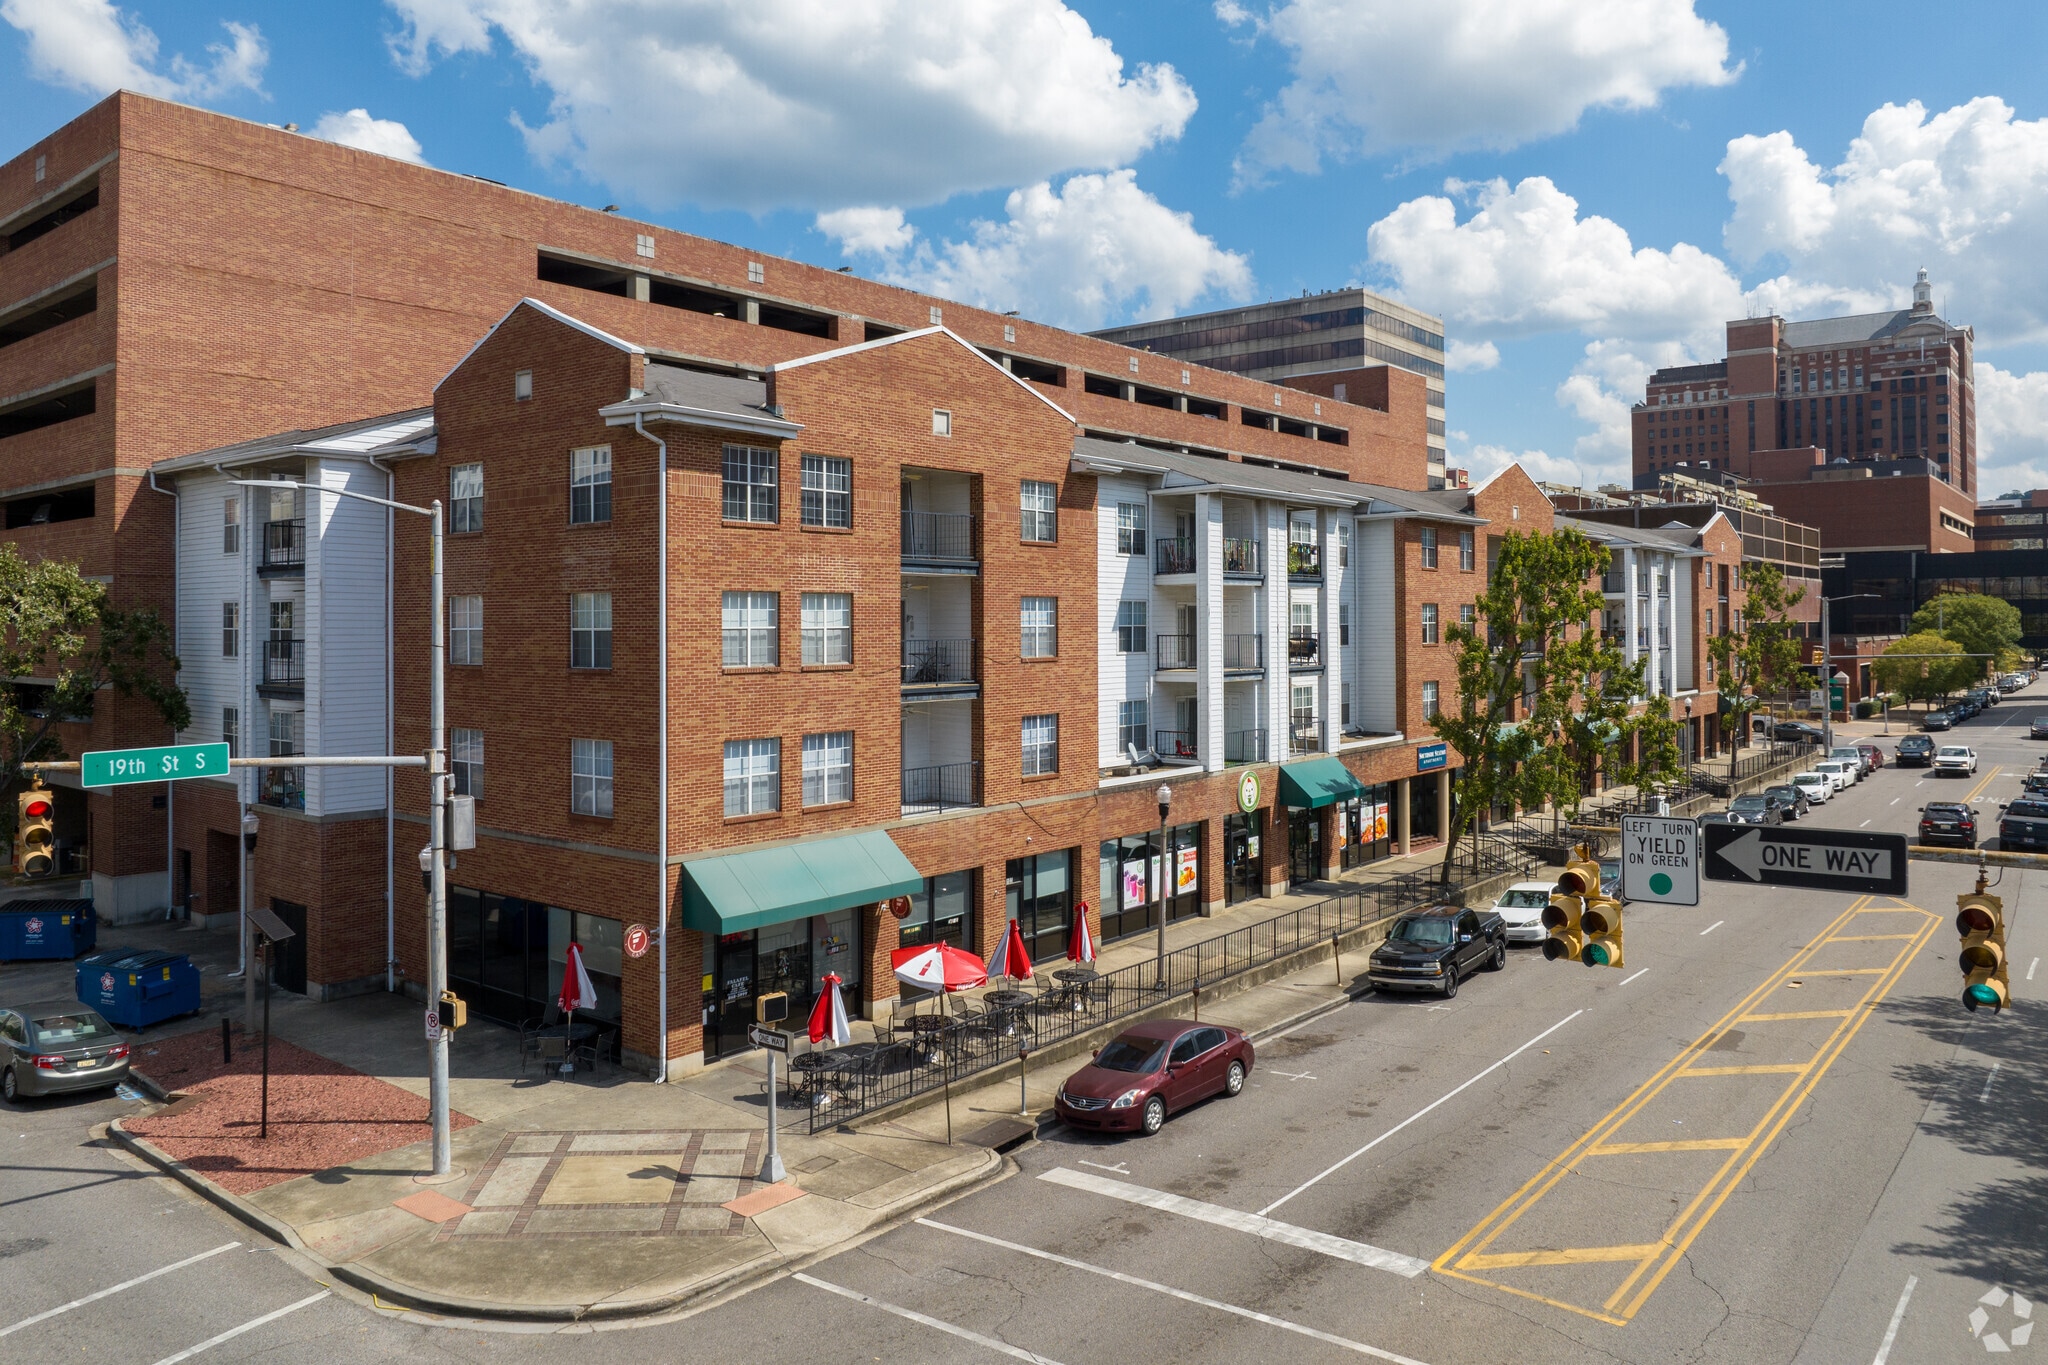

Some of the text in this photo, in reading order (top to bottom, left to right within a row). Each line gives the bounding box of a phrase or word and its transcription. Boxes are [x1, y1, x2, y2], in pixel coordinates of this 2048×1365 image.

[109, 752, 206, 777] 19th St S
[1625, 821, 1693, 836] LEFT TURN
[1637, 836, 1686, 855] YIELD
[1629, 853, 1689, 868] ON GREEN
[1762, 845, 1880, 874] ONE WAY
[758, 1033, 784, 1046] ONE WAY
